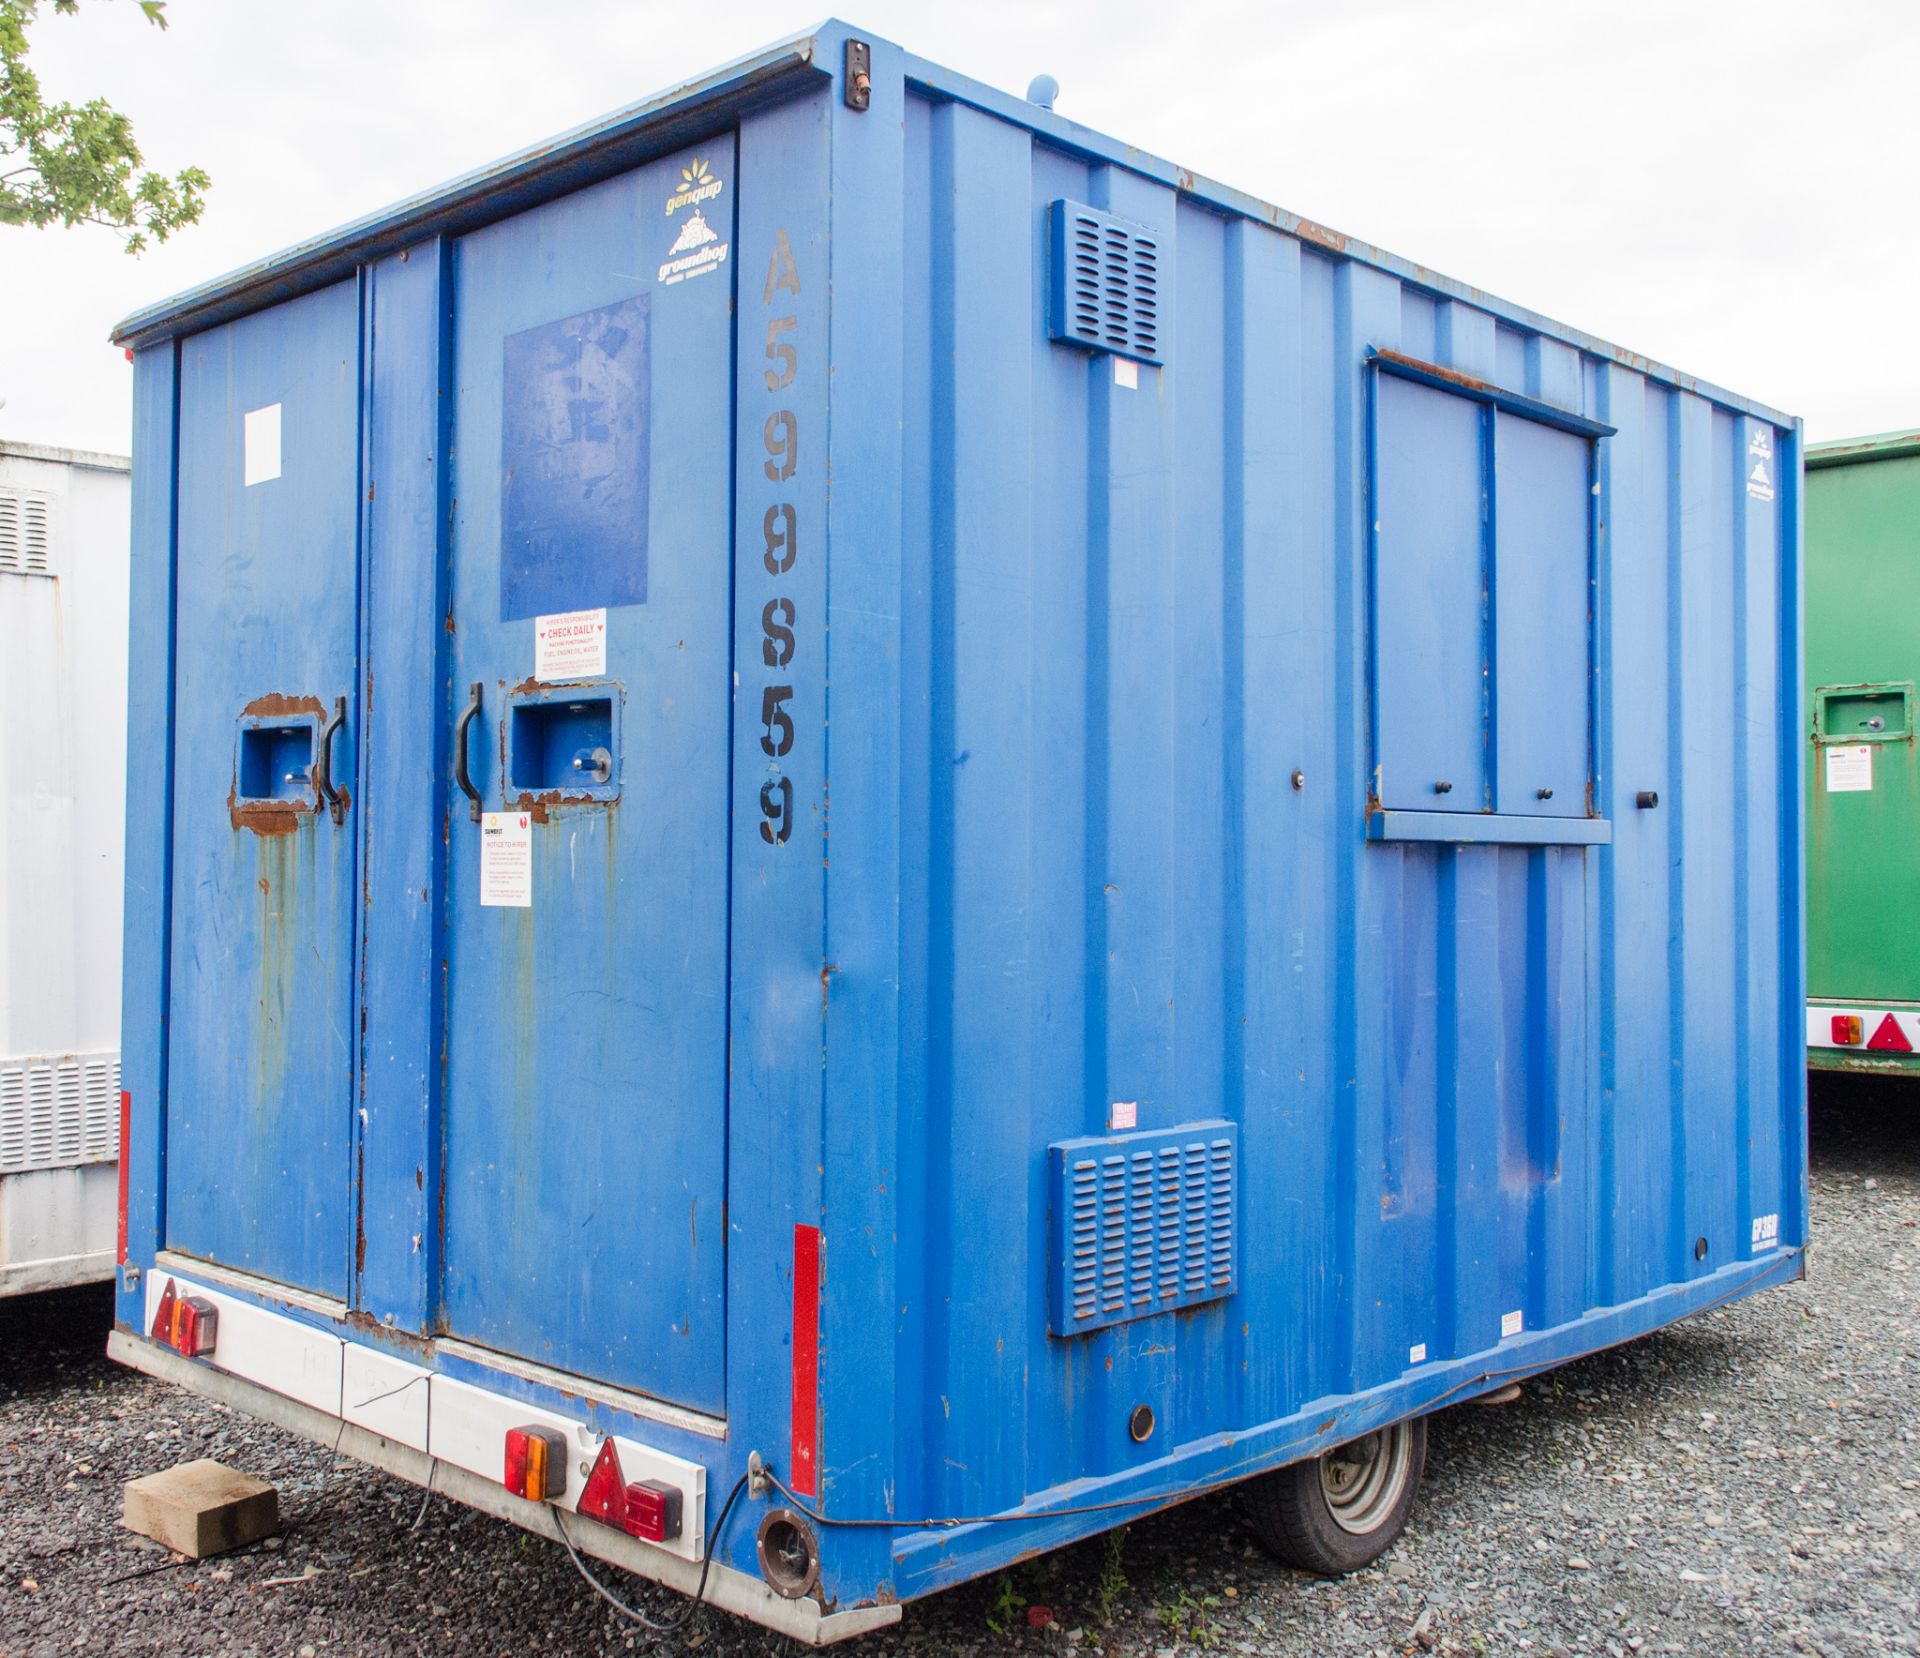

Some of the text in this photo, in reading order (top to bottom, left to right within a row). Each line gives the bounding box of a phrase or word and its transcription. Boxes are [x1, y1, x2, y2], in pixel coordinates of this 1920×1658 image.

[665, 180, 723, 216] genquip
[658, 243, 728, 281] groundhog
[548, 624, 594, 639] CHECK DAILY
